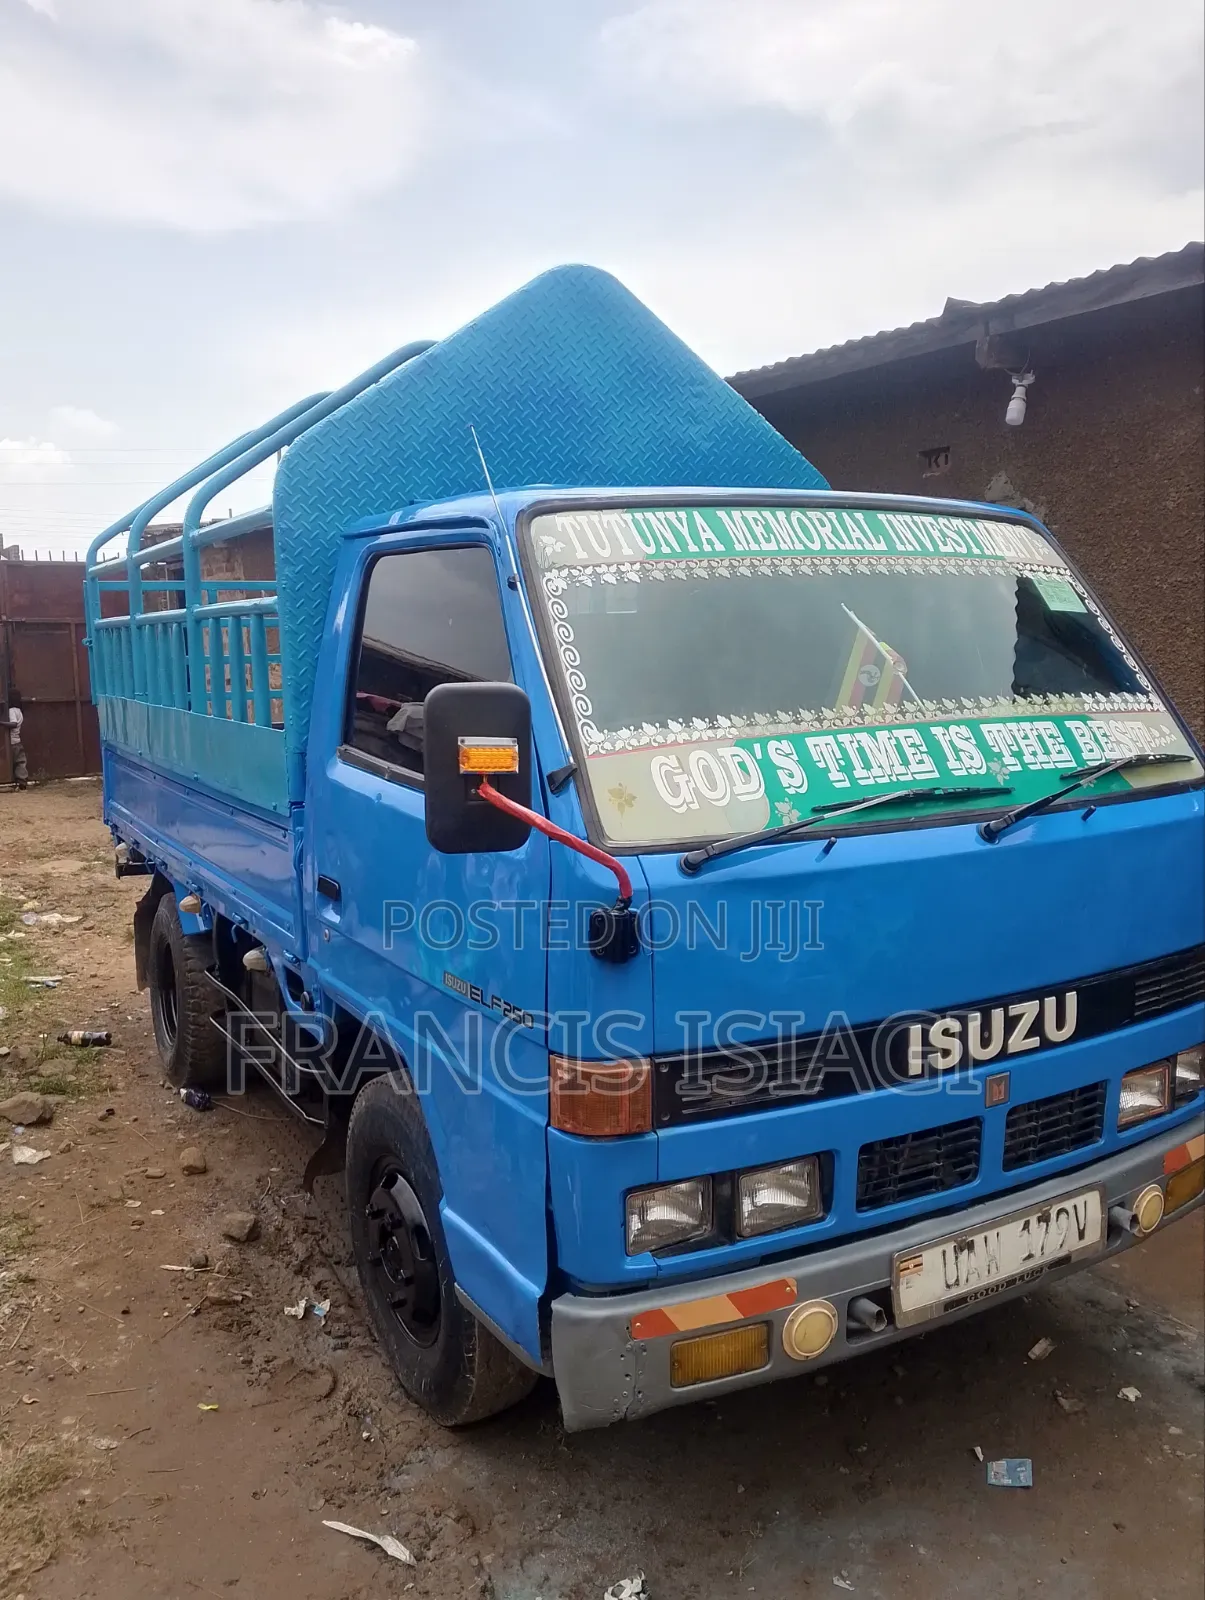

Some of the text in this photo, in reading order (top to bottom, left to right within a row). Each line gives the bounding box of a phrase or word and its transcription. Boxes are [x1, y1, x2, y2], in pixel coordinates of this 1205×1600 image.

[555, 510, 1045, 561] TUTUNYA MEMORIAL INVESTMENT
[650, 719, 1156, 814] GOD'S TIME IS THE BEST
[445, 973, 534, 1029] ISUZU ELF250
[907, 991, 1078, 1077] ISUZU
[967, 1282, 1006, 1303] GOOD
